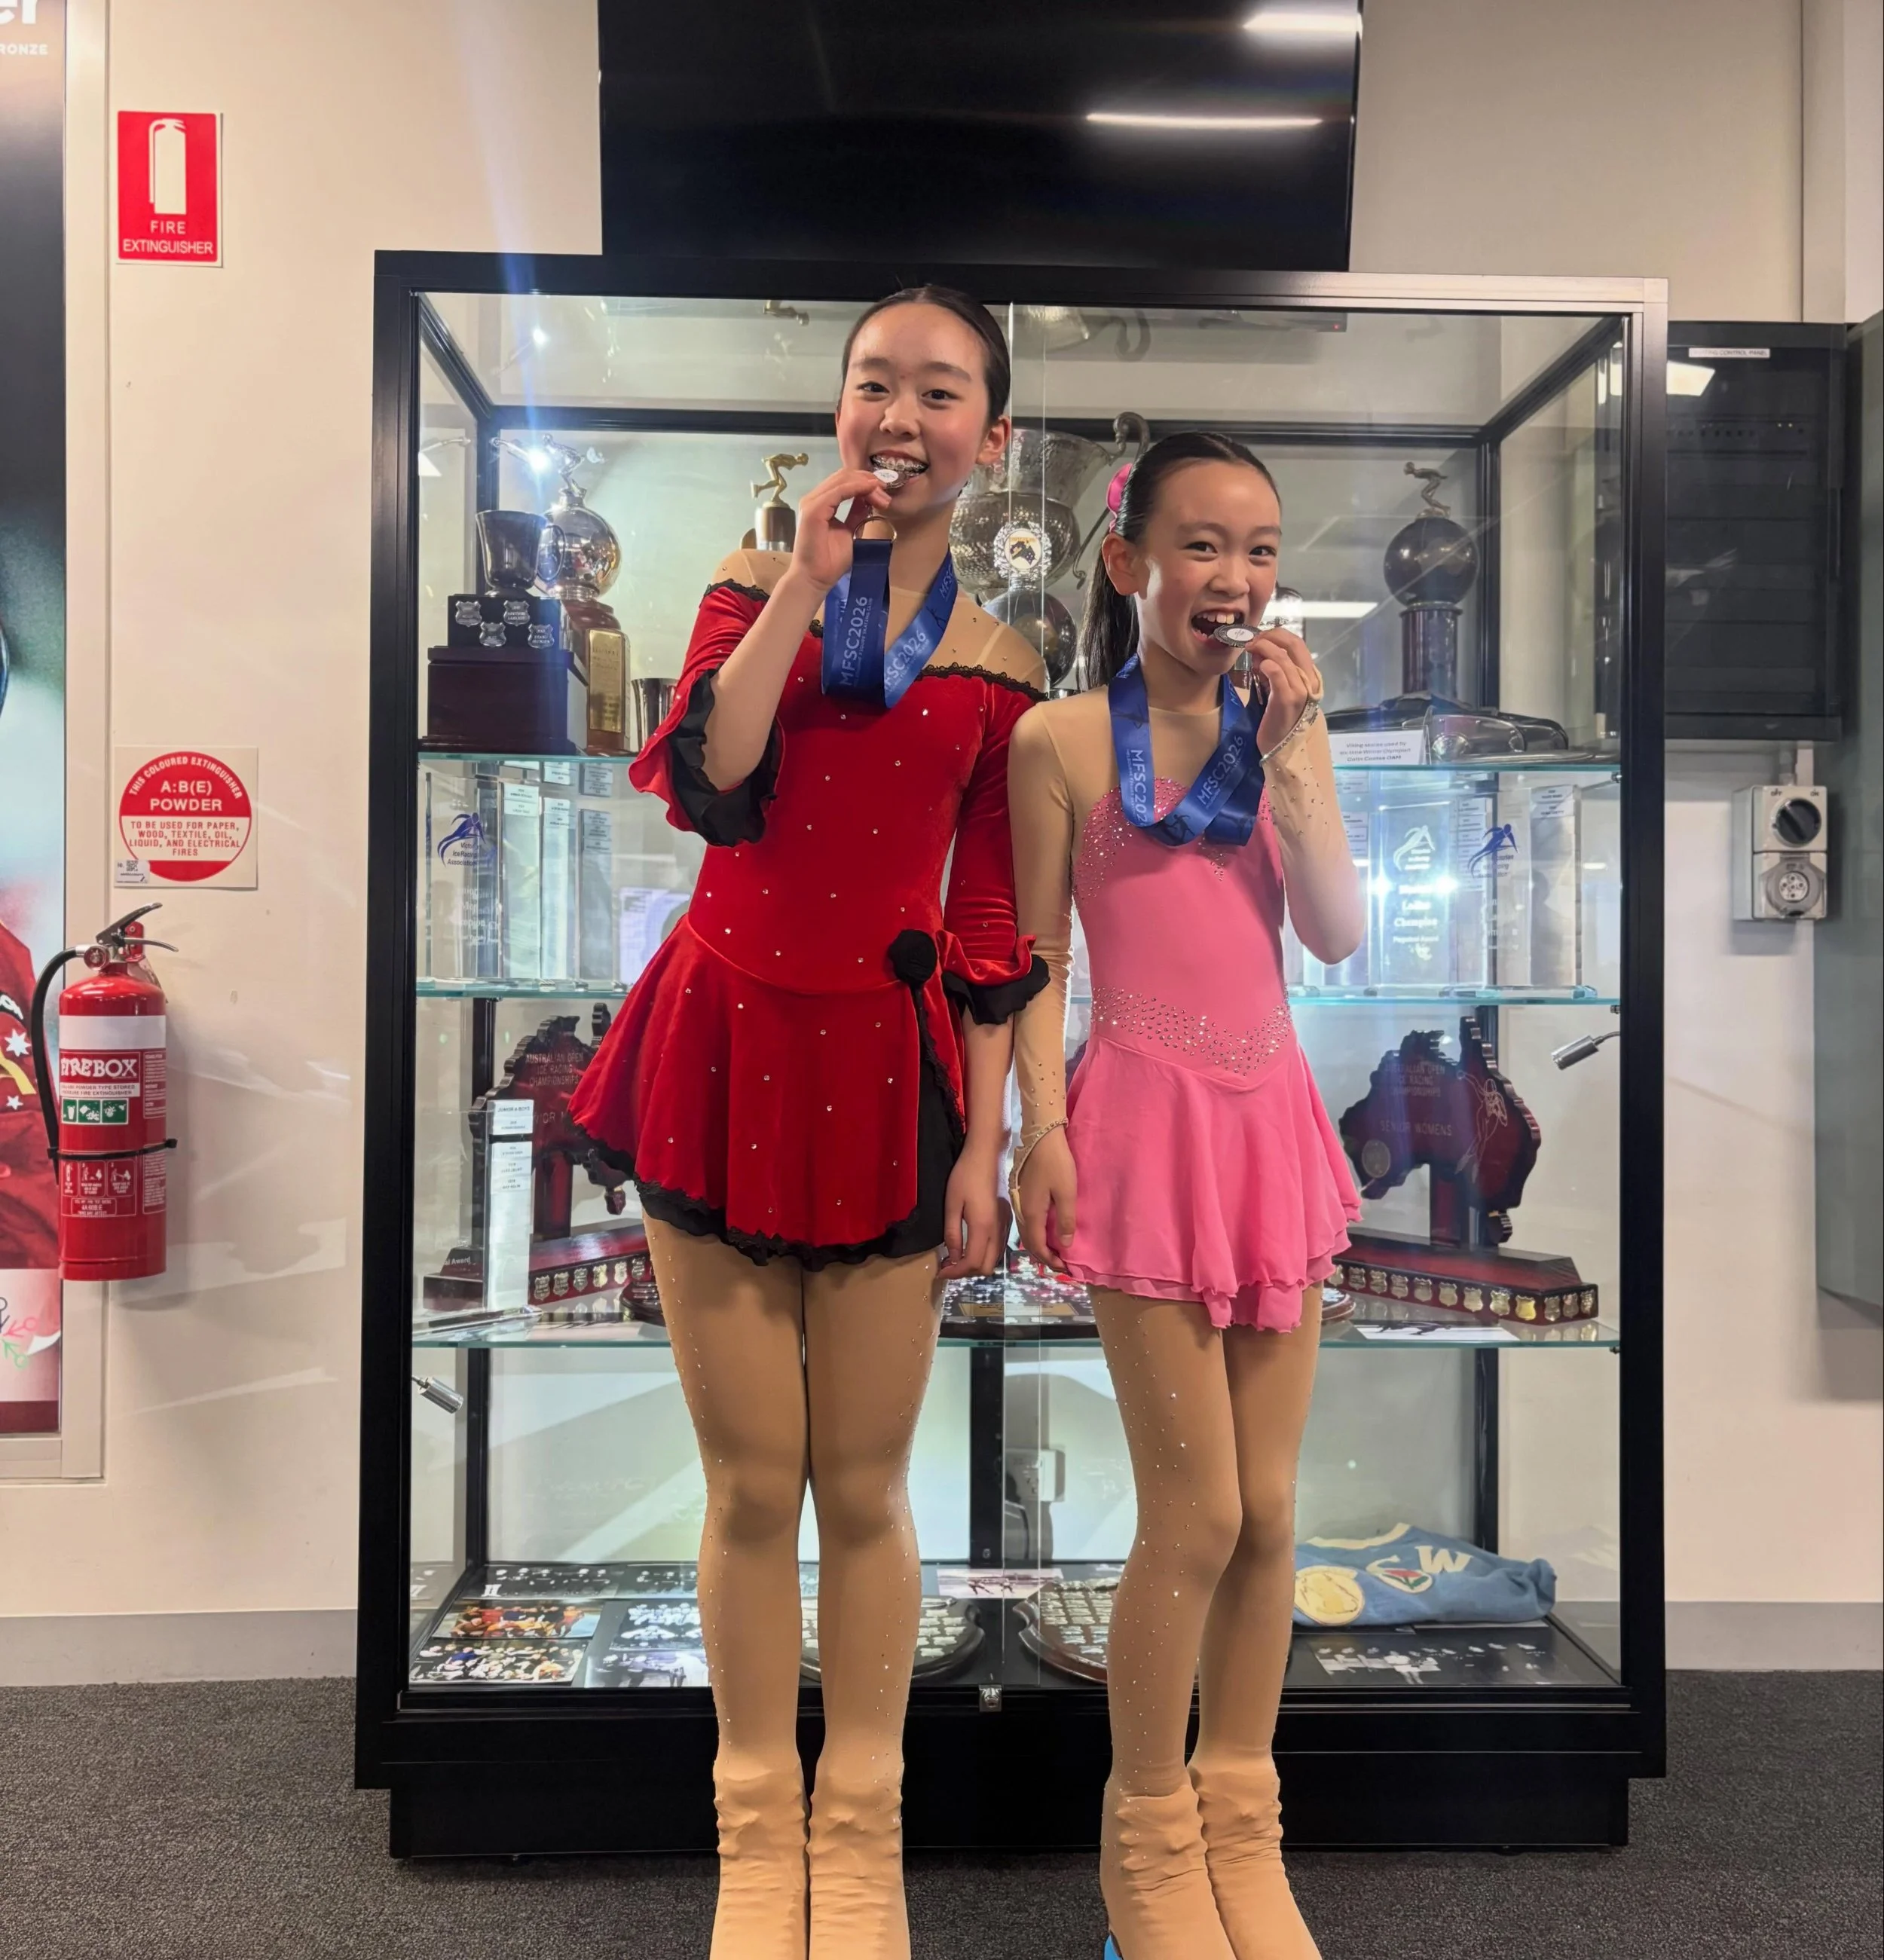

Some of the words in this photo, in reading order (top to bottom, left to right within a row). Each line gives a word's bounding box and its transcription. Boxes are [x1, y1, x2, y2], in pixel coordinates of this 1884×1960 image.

[150, 221, 186, 234] FIRE
[123, 239, 214, 255] EXTINGUISHER
[838, 596, 868, 686] MFSC2026
[884, 629, 926, 690] FSC2026
[129, 777, 145, 796] THIS
[144, 756, 188, 776] COLOURED
[191, 756, 243, 800] EXTINGUISHER
[1197, 735, 1243, 806] MFSC2026
[161, 781, 213, 796] A:B(E)
[150, 799, 222, 812] POWDER
[207, 822, 240, 831] PAPER,
[138, 830, 167, 839] WOOD,
[172, 831, 211, 839] TEXTILE,
[215, 831, 232, 839] OIL,
[130, 839, 163, 848] LIQUID,
[167, 839, 184, 848] AND
[188, 839, 241, 848] ELECTRICAL
[1414, 1545, 1473, 1574] W
